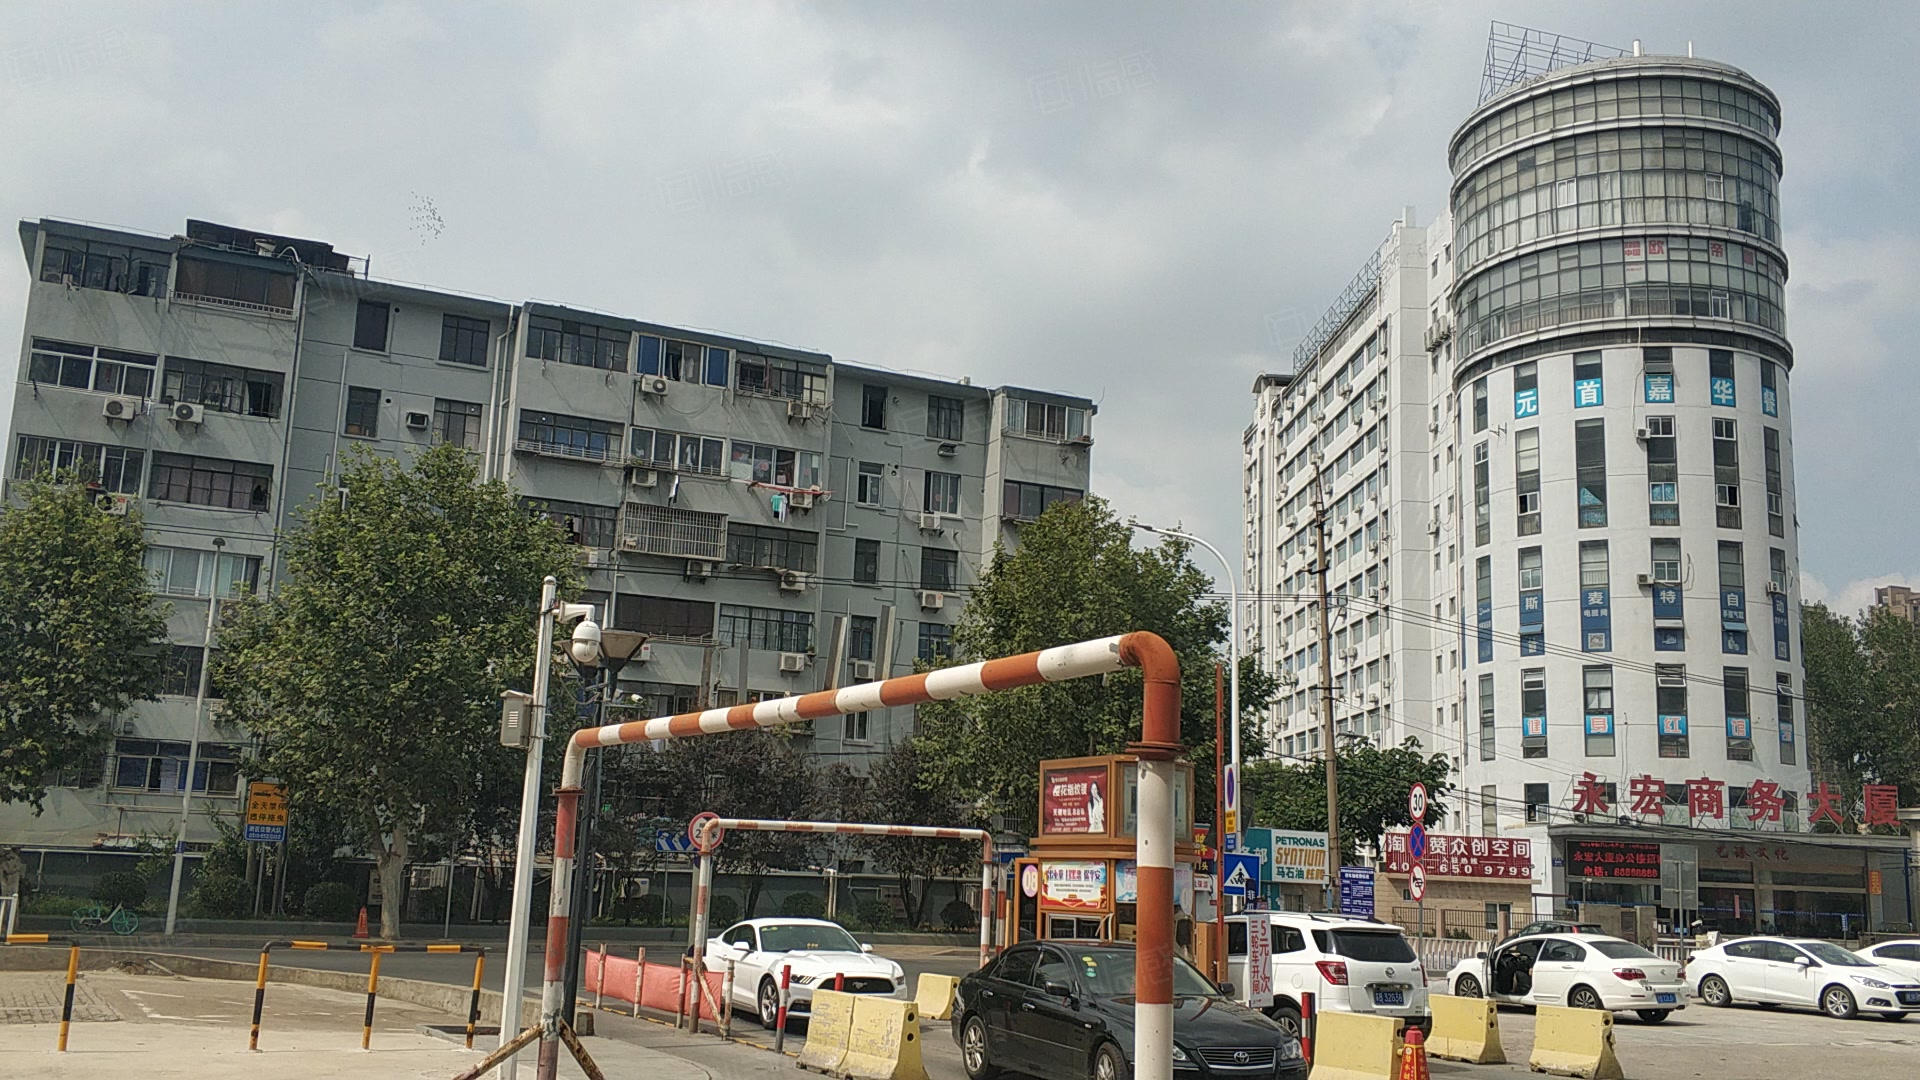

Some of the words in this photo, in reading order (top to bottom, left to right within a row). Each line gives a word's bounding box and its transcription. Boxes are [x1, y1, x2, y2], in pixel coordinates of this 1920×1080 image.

[1413, 793, 1423, 812] 30
[1572, 771, 1902, 827] 永宏商务大厦
[1275, 836, 1325, 847] PETRONAS
[1387, 834, 1531, 859] 淘赞众创空间
[1024, 874, 1037, 890] 08
